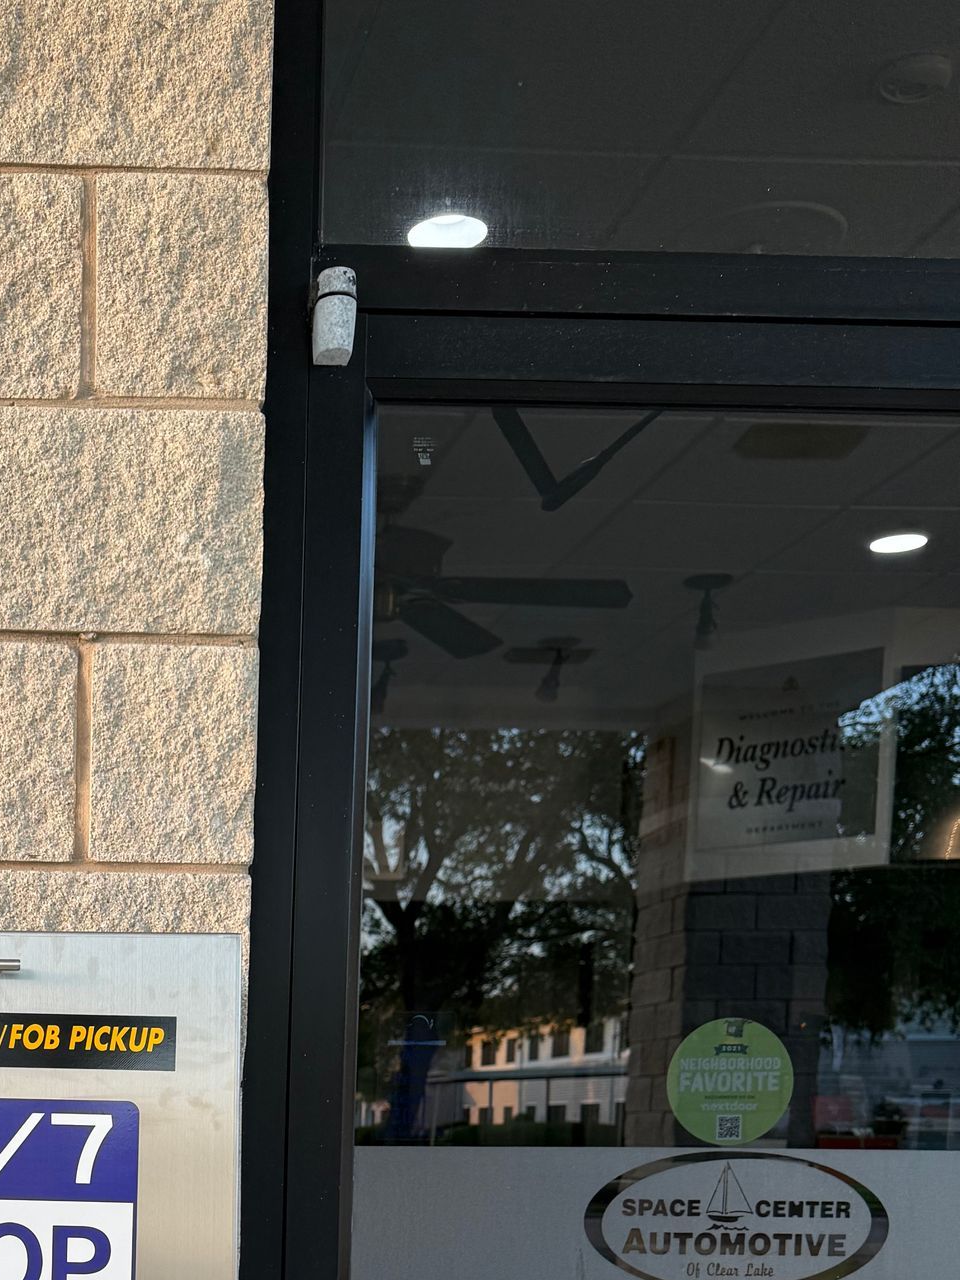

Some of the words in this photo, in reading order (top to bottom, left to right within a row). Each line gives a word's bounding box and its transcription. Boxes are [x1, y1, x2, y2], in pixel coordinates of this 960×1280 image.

[716, 729, 846, 771] Diagnosti
[728, 781, 749, 810] &
[754, 769, 847, 813] Repair
[745, 820, 823, 833] DEPARTMENT
[68, 1025, 165, 1053] PICKUP
[680, 1057, 781, 1070] NEIGHBORHOOD
[679, 1071, 781, 1092] FAVORITE
[702, 1100, 759, 1111] nextdoor
[622, 1199, 701, 1218] SPACE
[755, 1200, 851, 1219] CENTER
[622, 1228, 847, 1257] AUTOMOTIVE
[686, 1262, 701, 1278] Of
[706, 1261, 740, 1278] Clear
[744, 1263, 775, 1278] Lake
